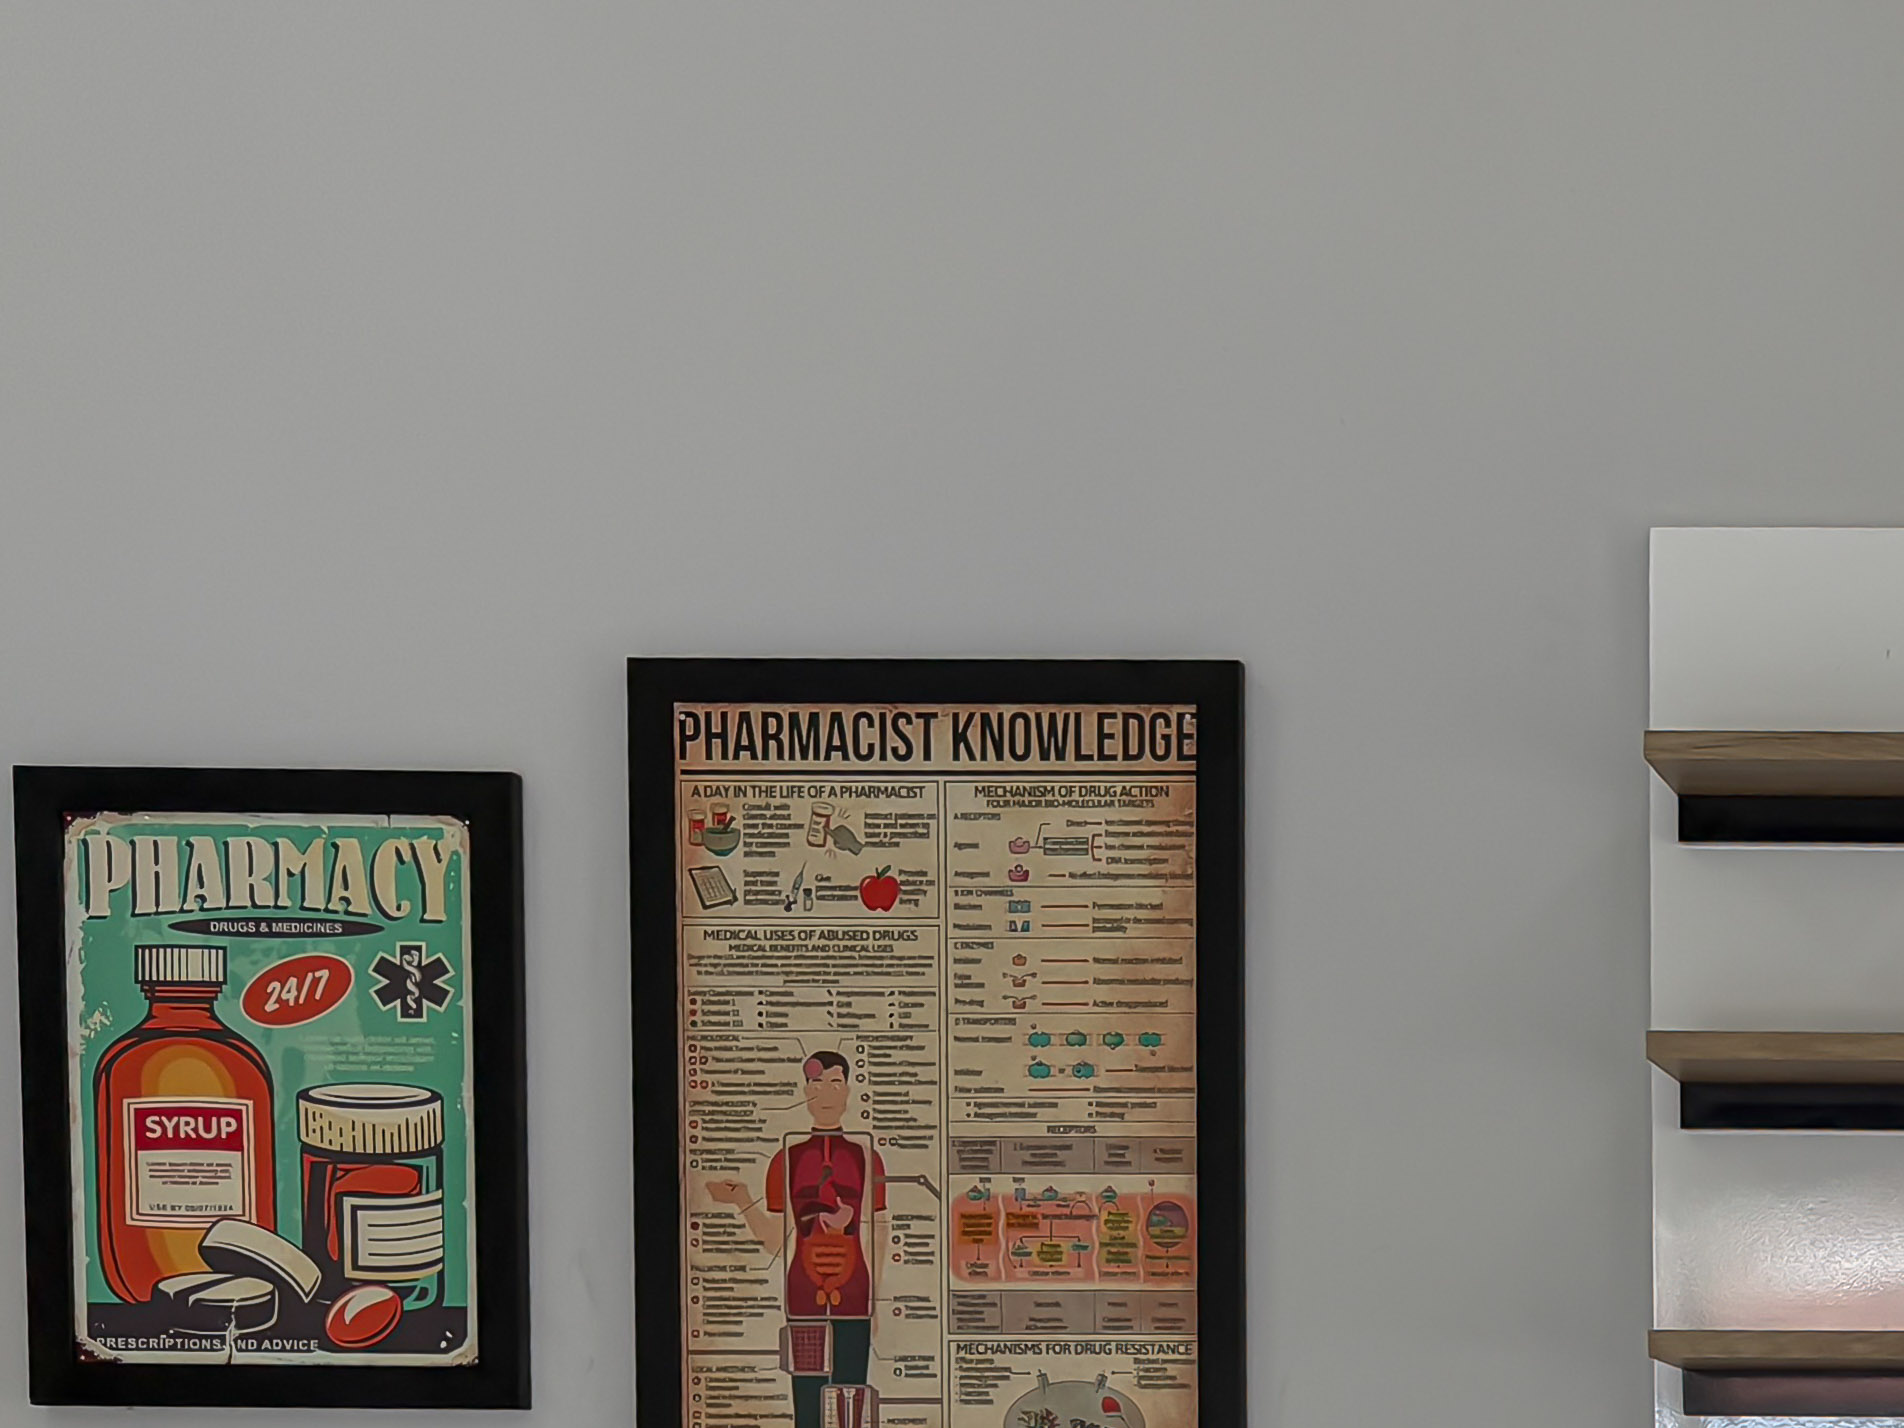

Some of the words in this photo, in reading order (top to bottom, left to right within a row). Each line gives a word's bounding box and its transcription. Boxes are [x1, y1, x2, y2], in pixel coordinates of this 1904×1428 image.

[679, 710, 938, 762] PHARMACIST
[951, 710, 1197, 762] KNOWLEDGE
[691, 786, 701, 798] A
[704, 786, 729, 798] DAY
[734, 786, 747, 798] IN
[751, 786, 777, 798] THE
[779, 786, 804, 798] LIFE
[807, 786, 826, 798] OF
[828, 786, 837, 798] A
[840, 786, 925, 798] PHARMACIST
[975, 786, 1055, 798] MECHANISM
[1058, 786, 1076, 798] OF
[1079, 786, 1116, 798] DRUG
[1119, 786, 1169, 798] ACTION
[79, 834, 451, 924] PHARMACY
[210, 922, 256, 932] DRUGS
[259, 922, 269, 932] &
[272, 922, 343, 933] MEDICINES
[703, 930, 760, 941] MEDICAL
[764, 930, 796, 941] USES
[798, 930, 815, 941] OF
[818, 930, 870, 941] ABUSED
[872, 930, 918, 941] DRUGS
[264, 969, 329, 1013] 24/7
[145, 1116, 237, 1138] SYRUP
[97, 1338, 221, 1349] PRESCRIPTIONS
[261, 1340, 318, 1350] ADVICE
[956, 1343, 1042, 1355] MECHANISMS
[1046, 1343, 1071, 1355] FOR
[1074, 1343, 1112, 1355] DRUG
[1115, 1343, 1192, 1355] RESISTANCE
